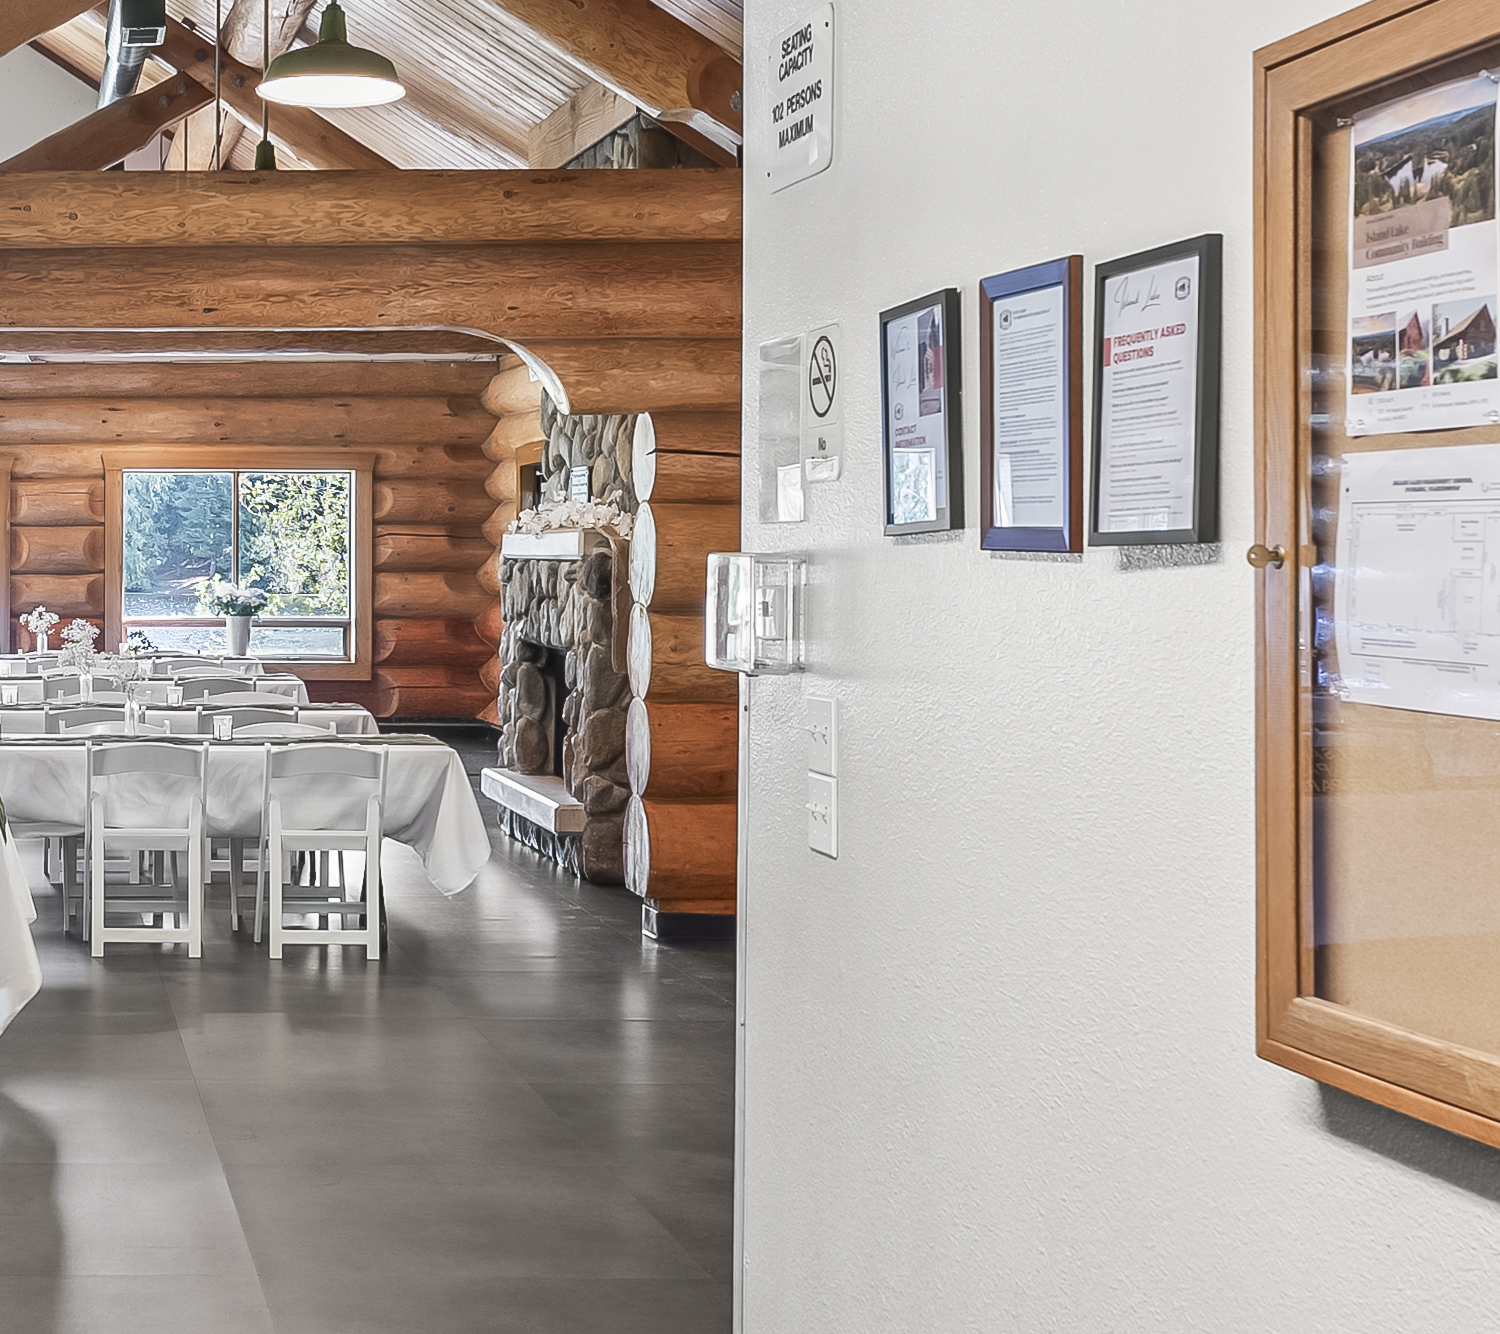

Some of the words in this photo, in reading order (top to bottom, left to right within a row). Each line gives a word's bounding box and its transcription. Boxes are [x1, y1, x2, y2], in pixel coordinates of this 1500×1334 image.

[782, 23, 812, 59] SEATING
[779, 43, 814, 82] CAPACITY
[772, 102, 784, 124] 102
[787, 79, 822, 116] PERSONS
[779, 114, 814, 149] MAXIMUM
[1113, 328, 1160, 348] FREQUENTLY
[1160, 323, 1186, 339] ASKED
[1113, 346, 1154, 365] QUESTIONS
